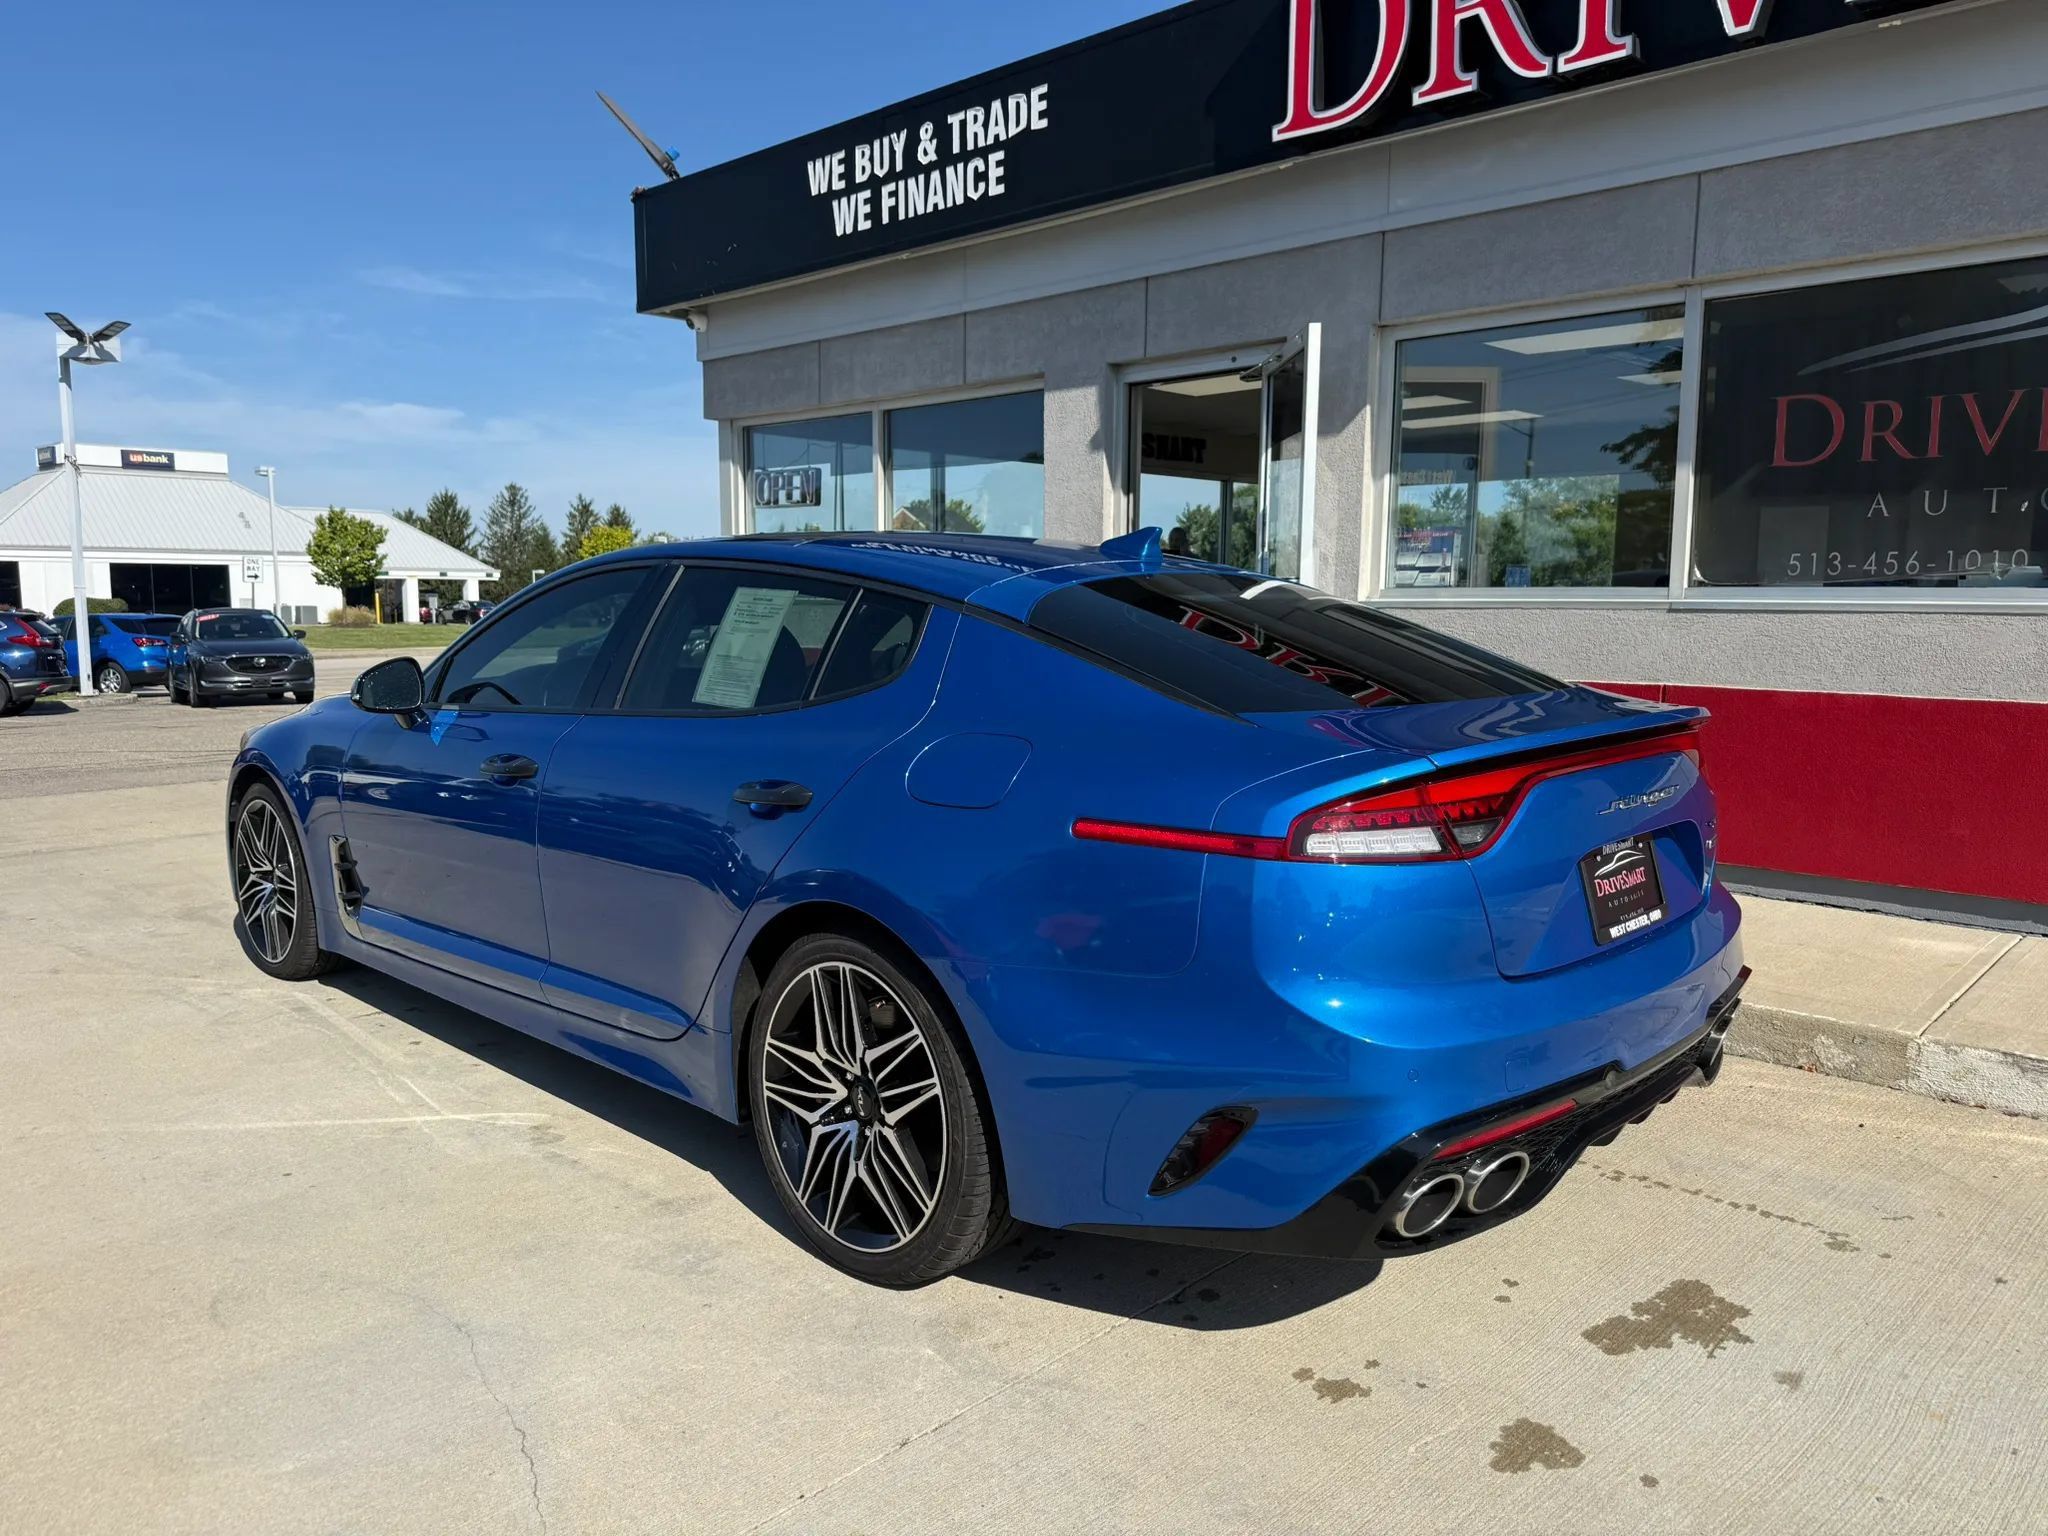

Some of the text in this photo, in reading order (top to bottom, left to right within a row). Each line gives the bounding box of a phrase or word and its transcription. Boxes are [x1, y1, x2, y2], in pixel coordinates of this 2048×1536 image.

[807, 83, 1048, 196] WE BUY & TRADE
[832, 150, 1005, 237] WE FINANCE
[756, 470, 816, 506] OPEN
[1867, 487, 2048, 518] AUT
[1787, 549, 2029, 576] 513-456-1010
[1609, 923, 1627, 939] WEST
